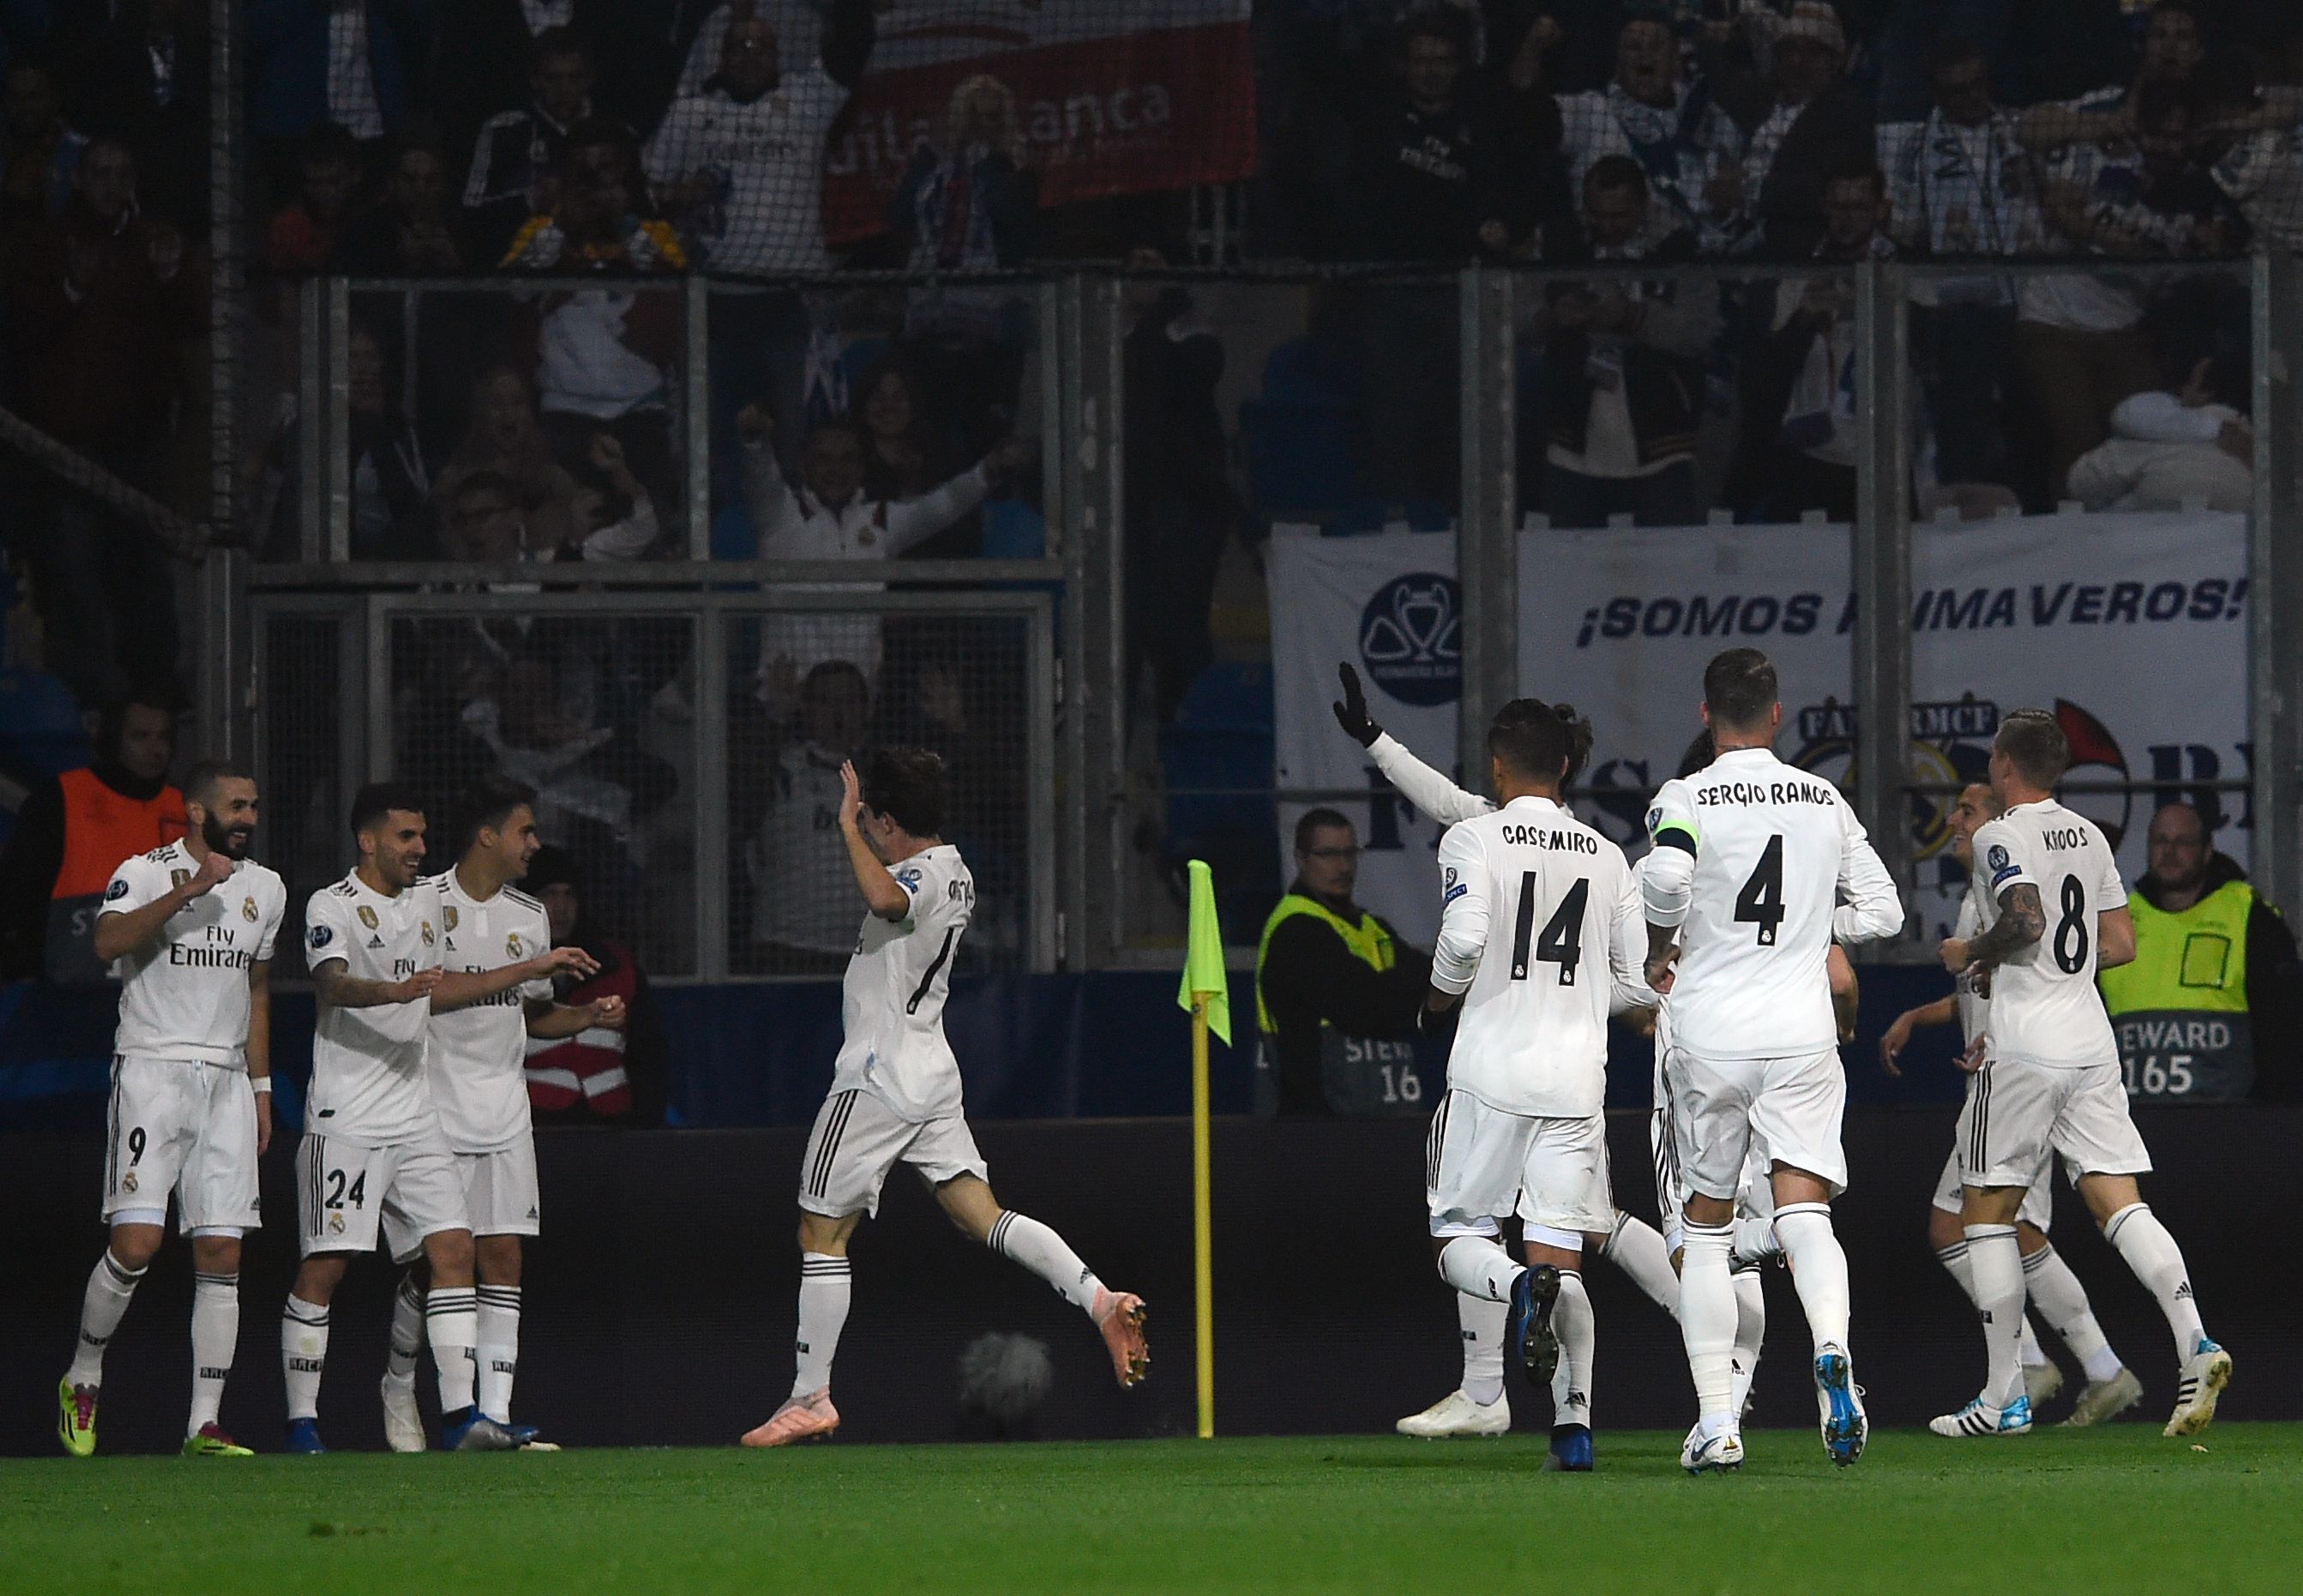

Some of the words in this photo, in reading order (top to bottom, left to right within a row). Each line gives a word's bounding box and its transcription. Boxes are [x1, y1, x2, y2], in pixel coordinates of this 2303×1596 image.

[1576, 593, 1824, 648] ¡SOMOS
[1697, 783, 1766, 807] SERGIO
[1771, 781, 1835, 806] RAMOS
[1501, 825, 1598, 855] CASEMIRO
[1734, 834, 1786, 946] 4
[207, 926, 235, 945] Fly
[1510, 870, 1590, 987] 14
[2053, 873, 2089, 975] 8
[170, 942, 251, 971] Emirate
[2118, 1021, 2231, 1053] EWARD
[2124, 1054, 2193, 1096] 165
[129, 1126, 147, 1167] 9
[325, 1169, 366, 1210] 24
